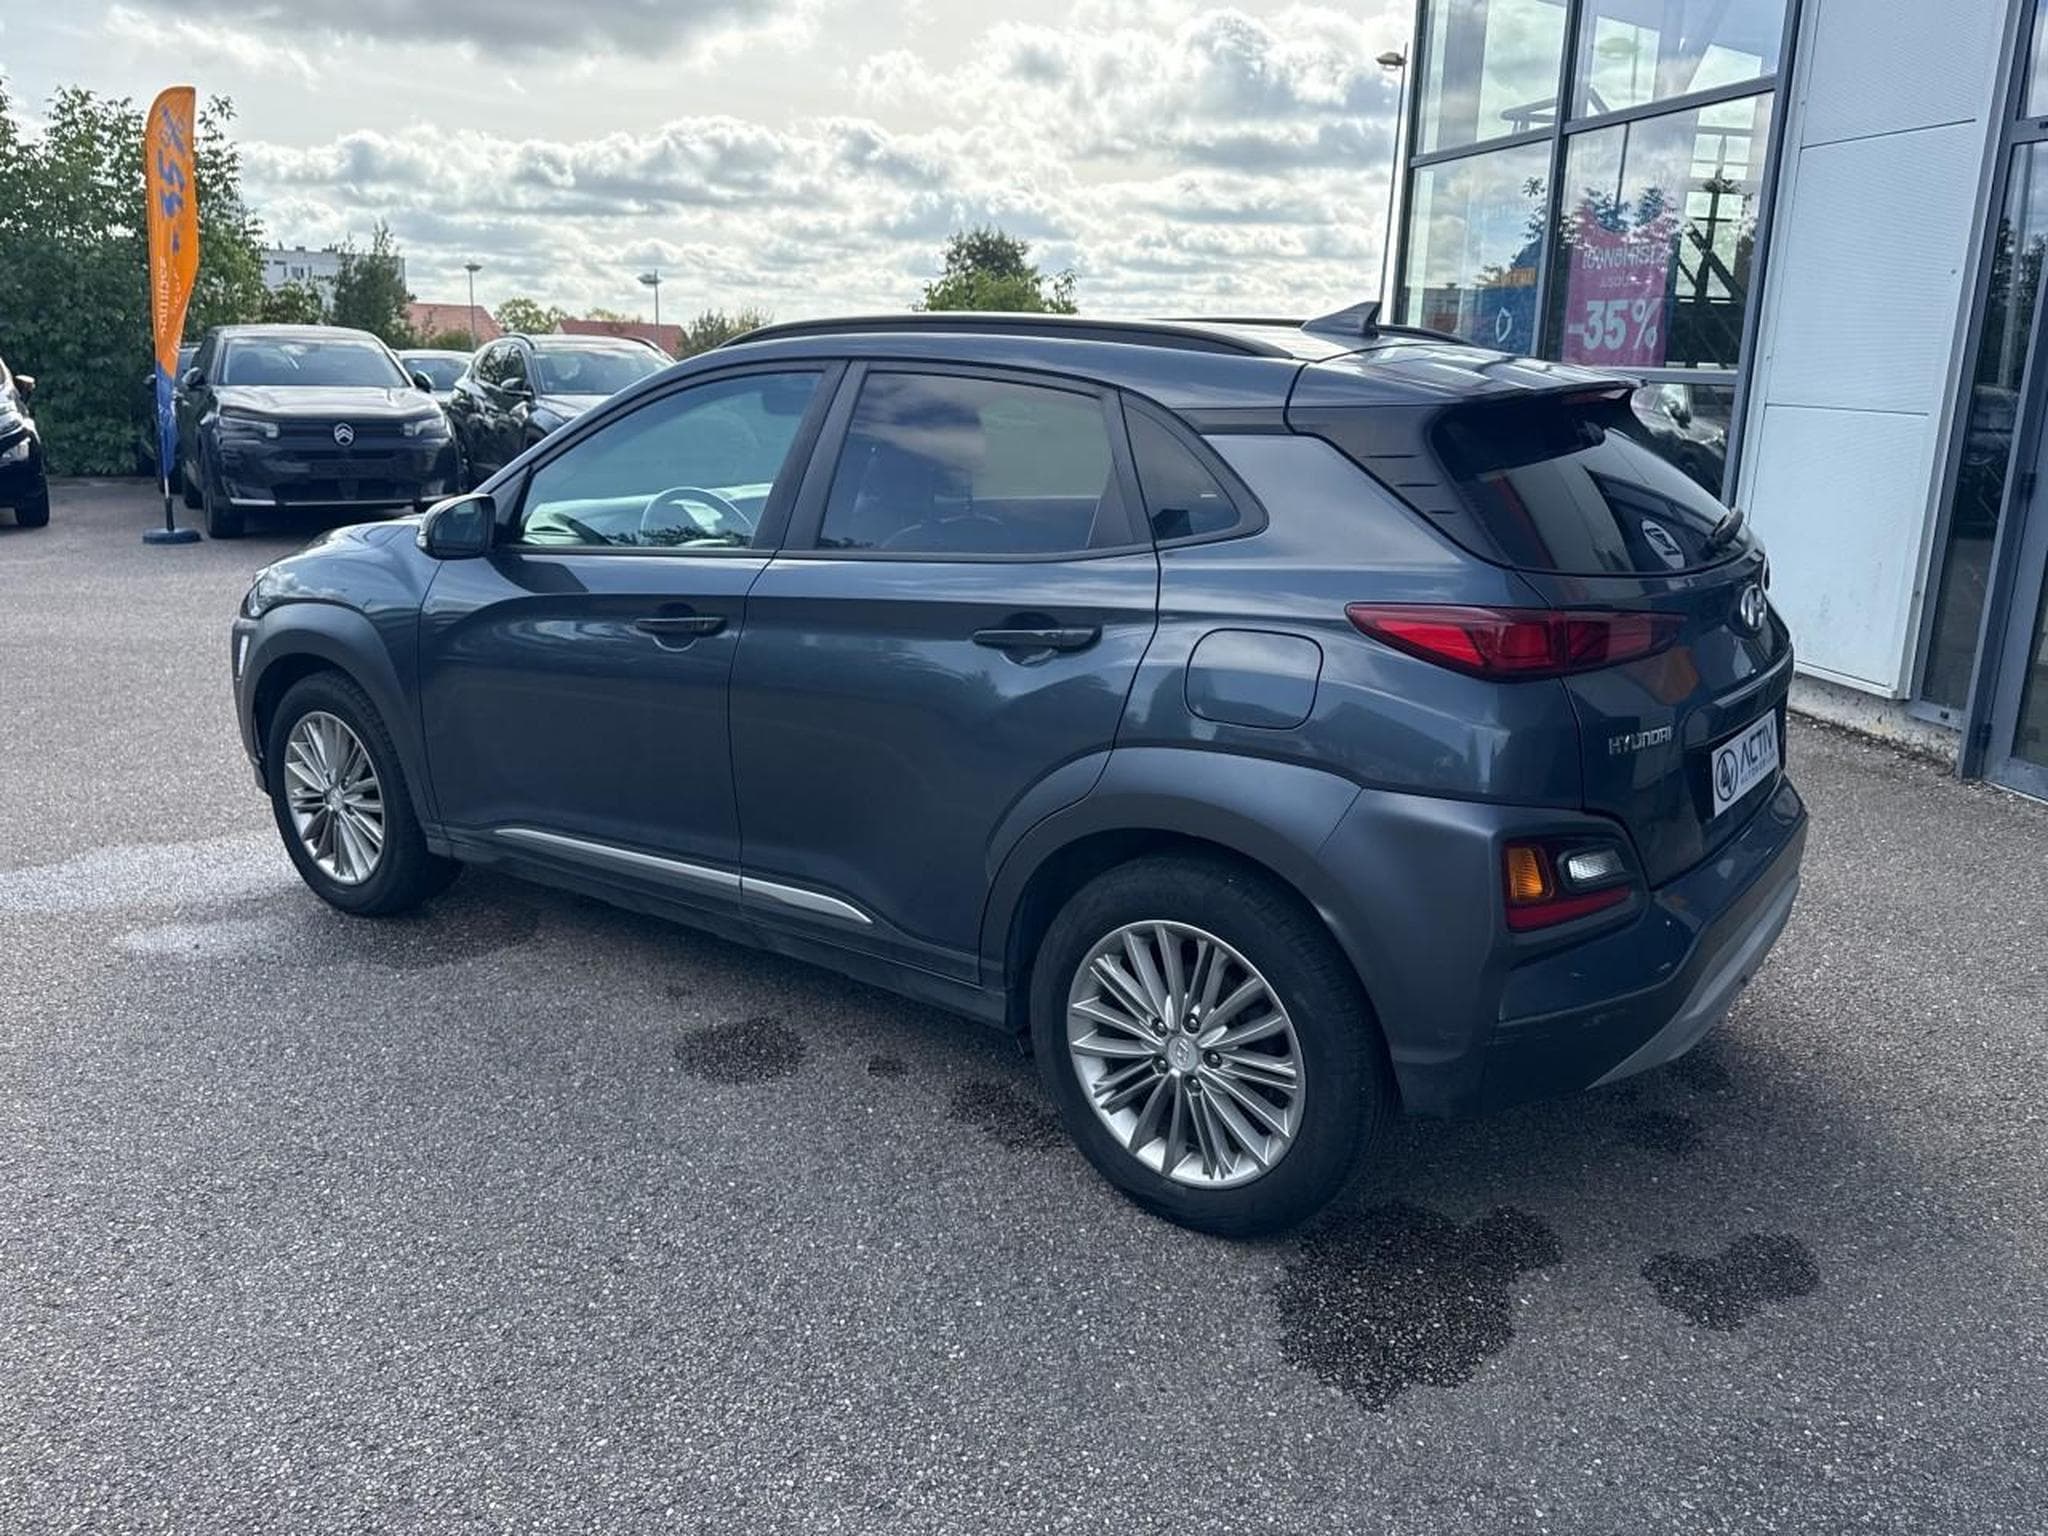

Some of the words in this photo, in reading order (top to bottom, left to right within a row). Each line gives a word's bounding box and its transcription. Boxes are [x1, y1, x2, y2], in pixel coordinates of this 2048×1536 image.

[1568, 297, 1662, 350] -35%
[1608, 725, 1672, 755] HYUNDAI
[1740, 718, 1774, 775] ACTIV
